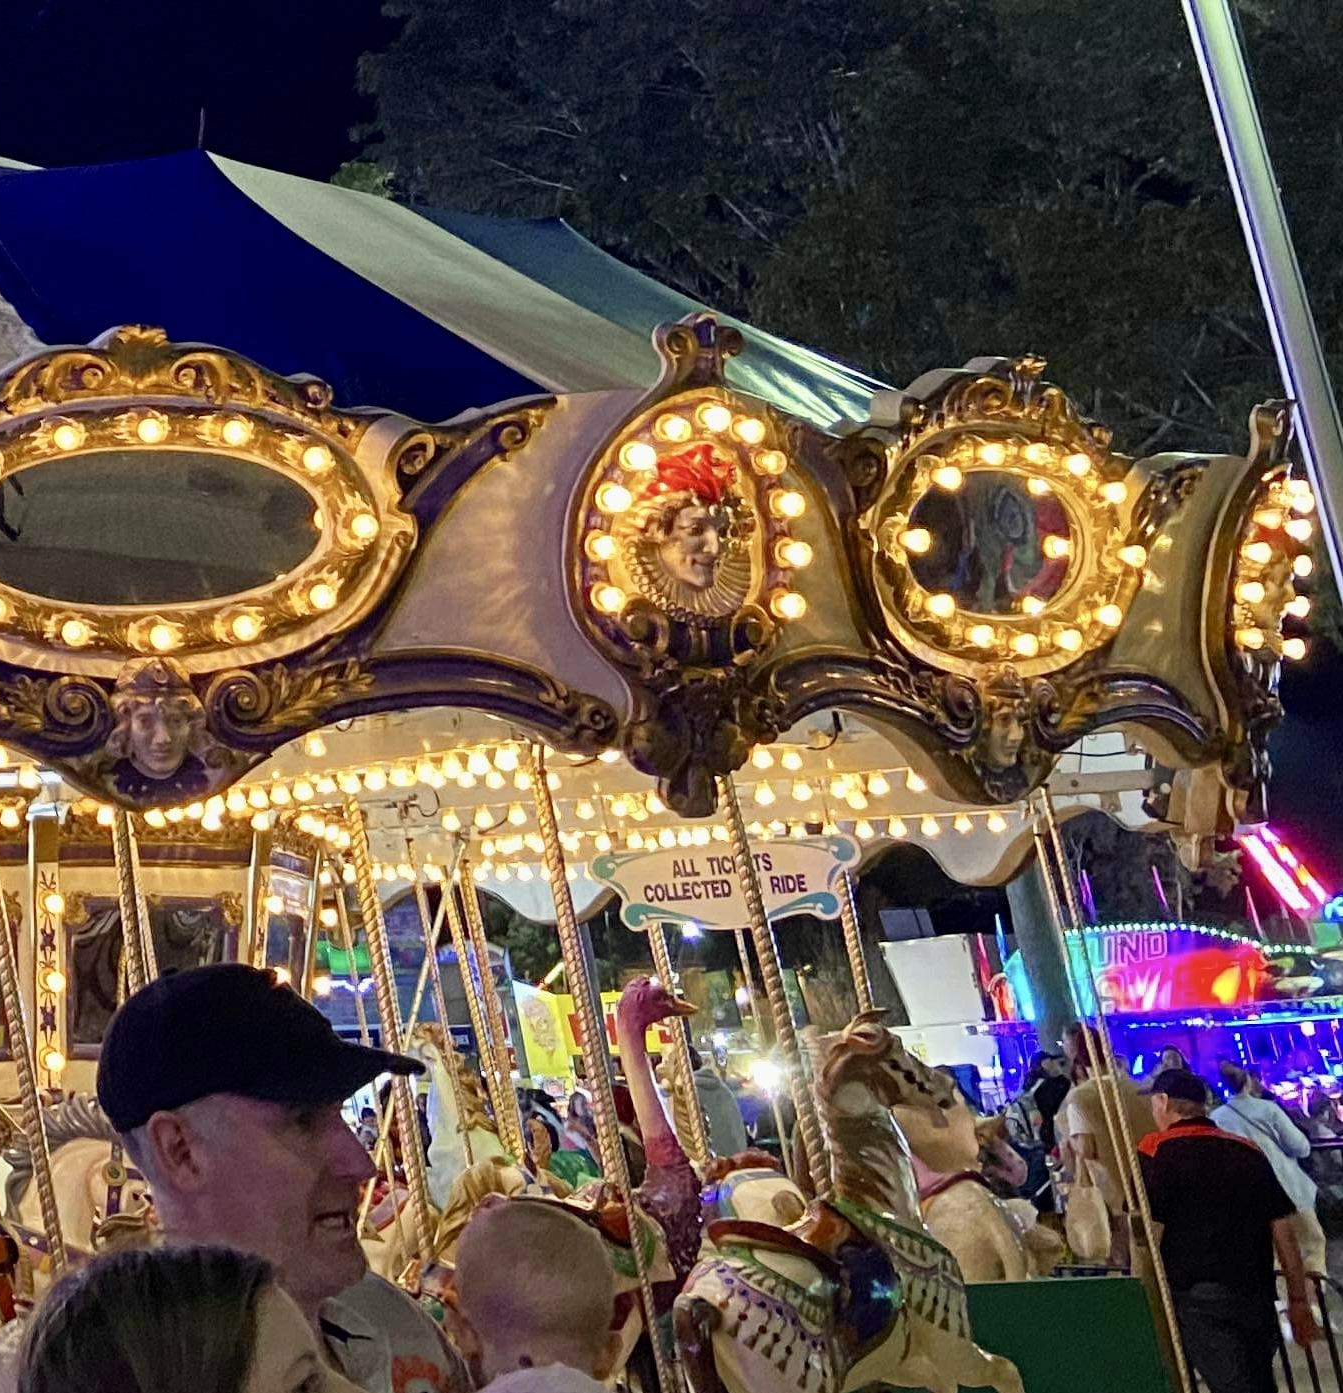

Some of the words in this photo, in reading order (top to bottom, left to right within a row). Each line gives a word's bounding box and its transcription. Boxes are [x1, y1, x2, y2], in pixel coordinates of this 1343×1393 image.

[672, 857, 701, 879] ALL
[706, 852, 773, 877] TICTS
[643, 878, 732, 903] COLLECTED
[770, 874, 808, 895] RIDE
